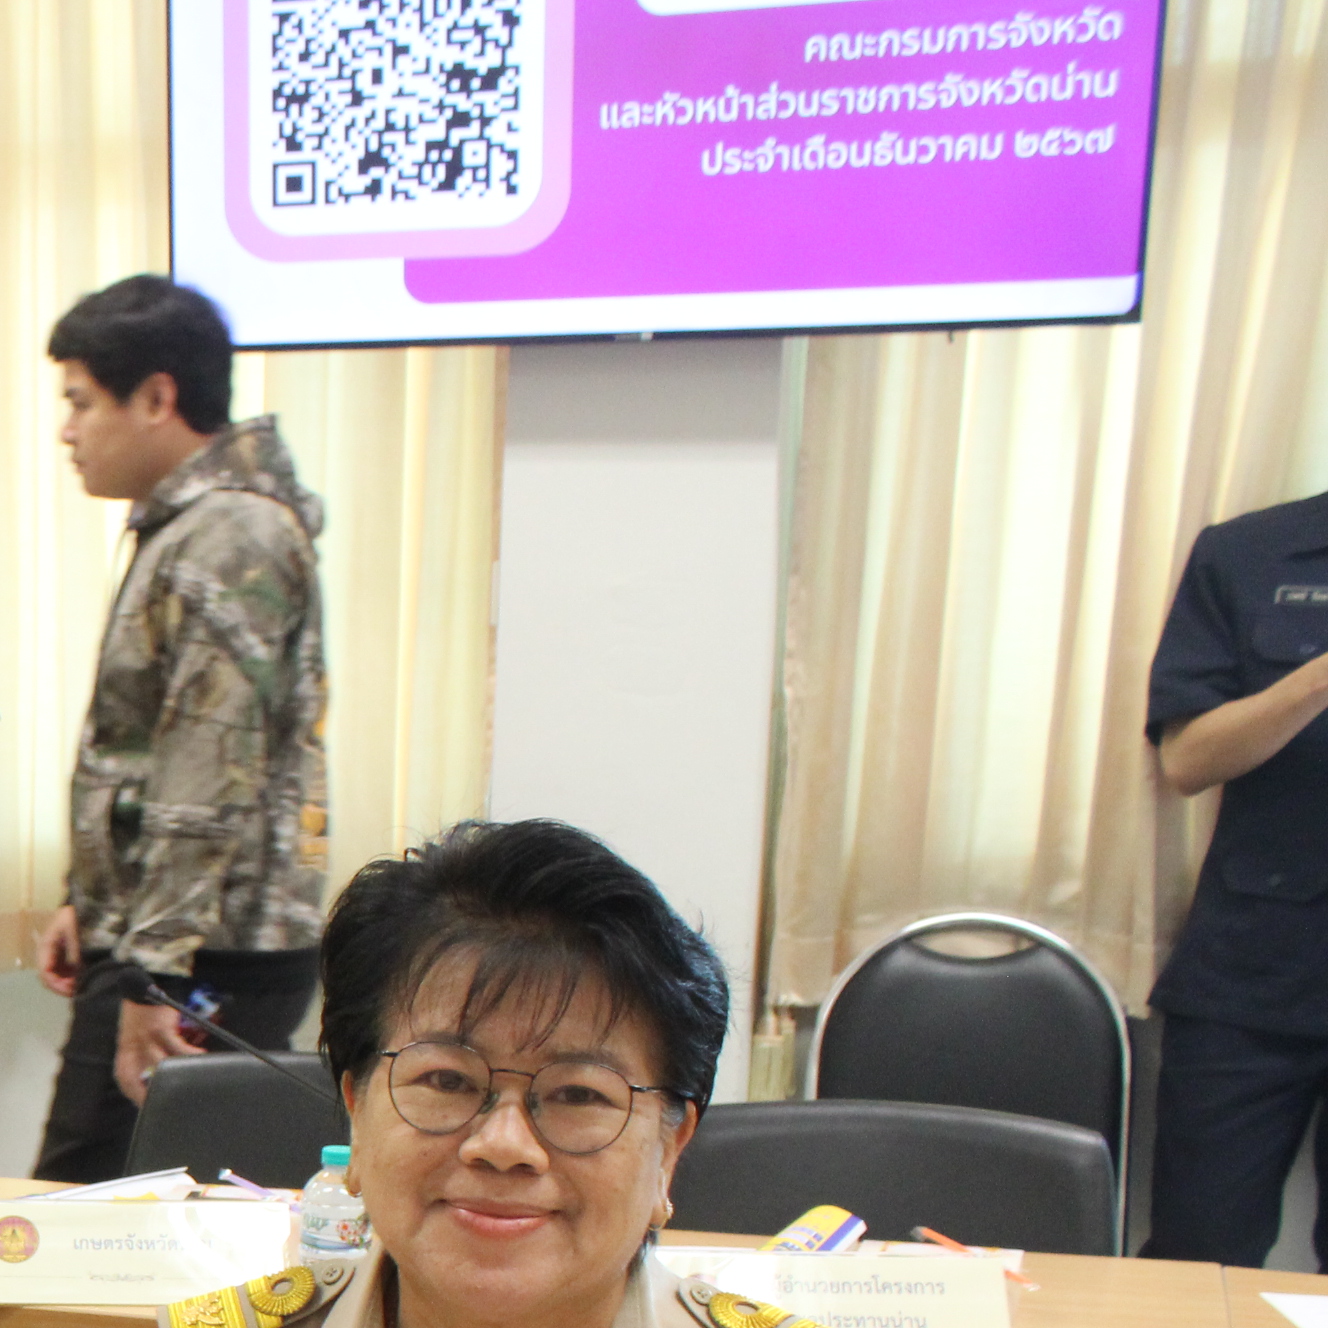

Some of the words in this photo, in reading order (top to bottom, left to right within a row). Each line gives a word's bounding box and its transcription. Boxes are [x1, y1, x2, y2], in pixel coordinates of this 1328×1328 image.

[804, 5, 1125, 63] คณะกรมการจังหวัด
[599, 60, 1120, 131] และหัวหน้าส่วนราชการจังหวัดน่าน
[700, 128, 1005, 177] ประจำเดือนธันวาคม
[1012, 121, 1118, 159] ๒๕๖๗
